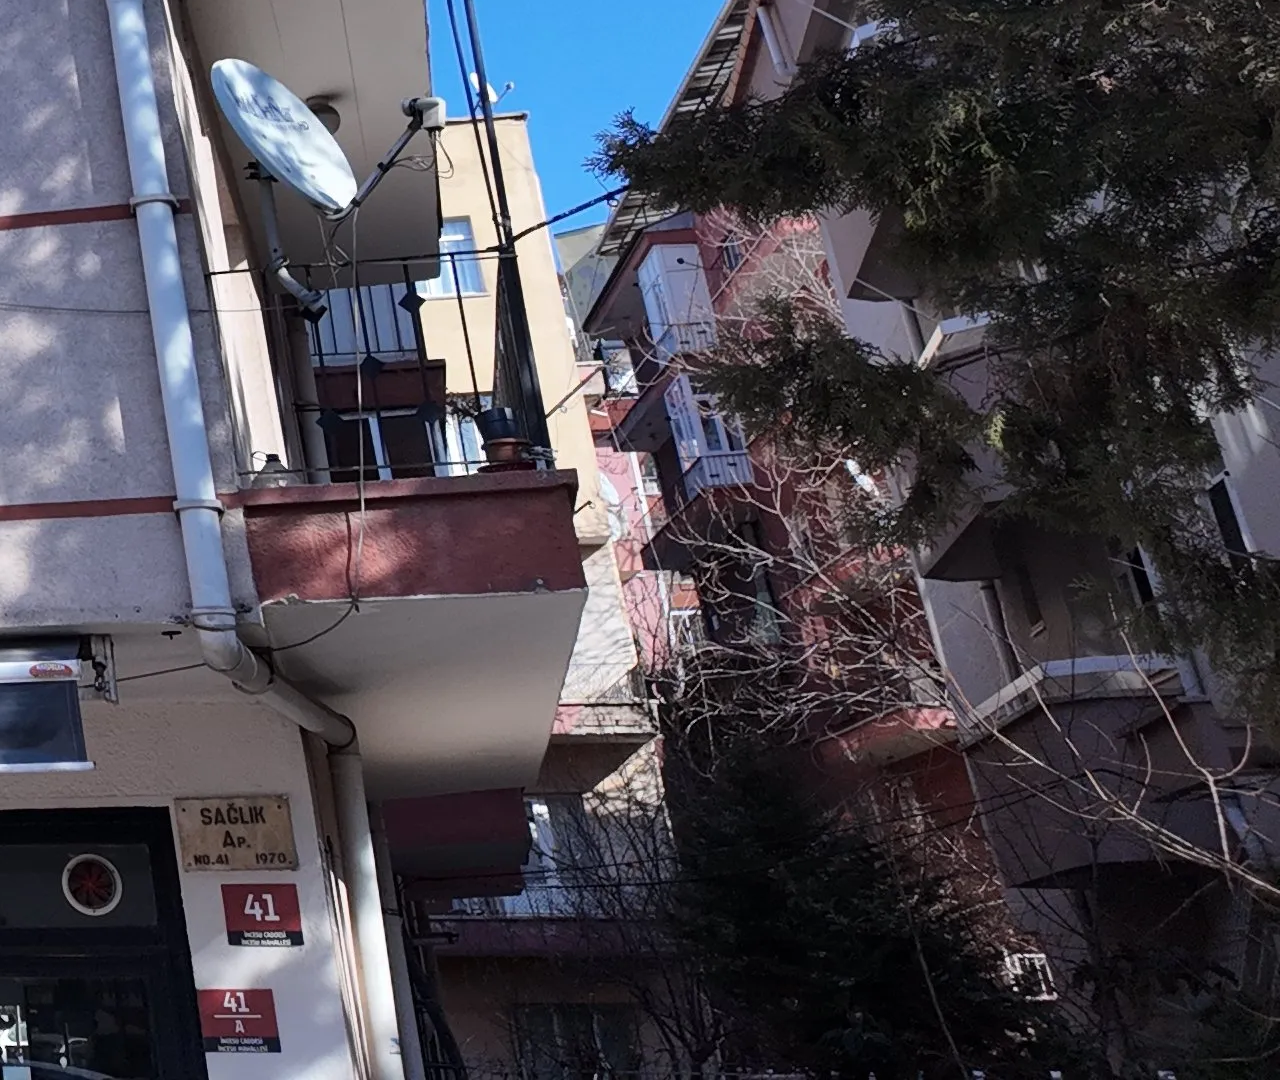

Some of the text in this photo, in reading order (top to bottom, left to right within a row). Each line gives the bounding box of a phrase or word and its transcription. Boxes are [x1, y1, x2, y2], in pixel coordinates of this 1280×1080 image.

[200, 802, 267, 826] SAĞLIK
[244, 893, 281, 922] 41
[223, 991, 250, 1013] 41
[235, 1019, 245, 1033] A
